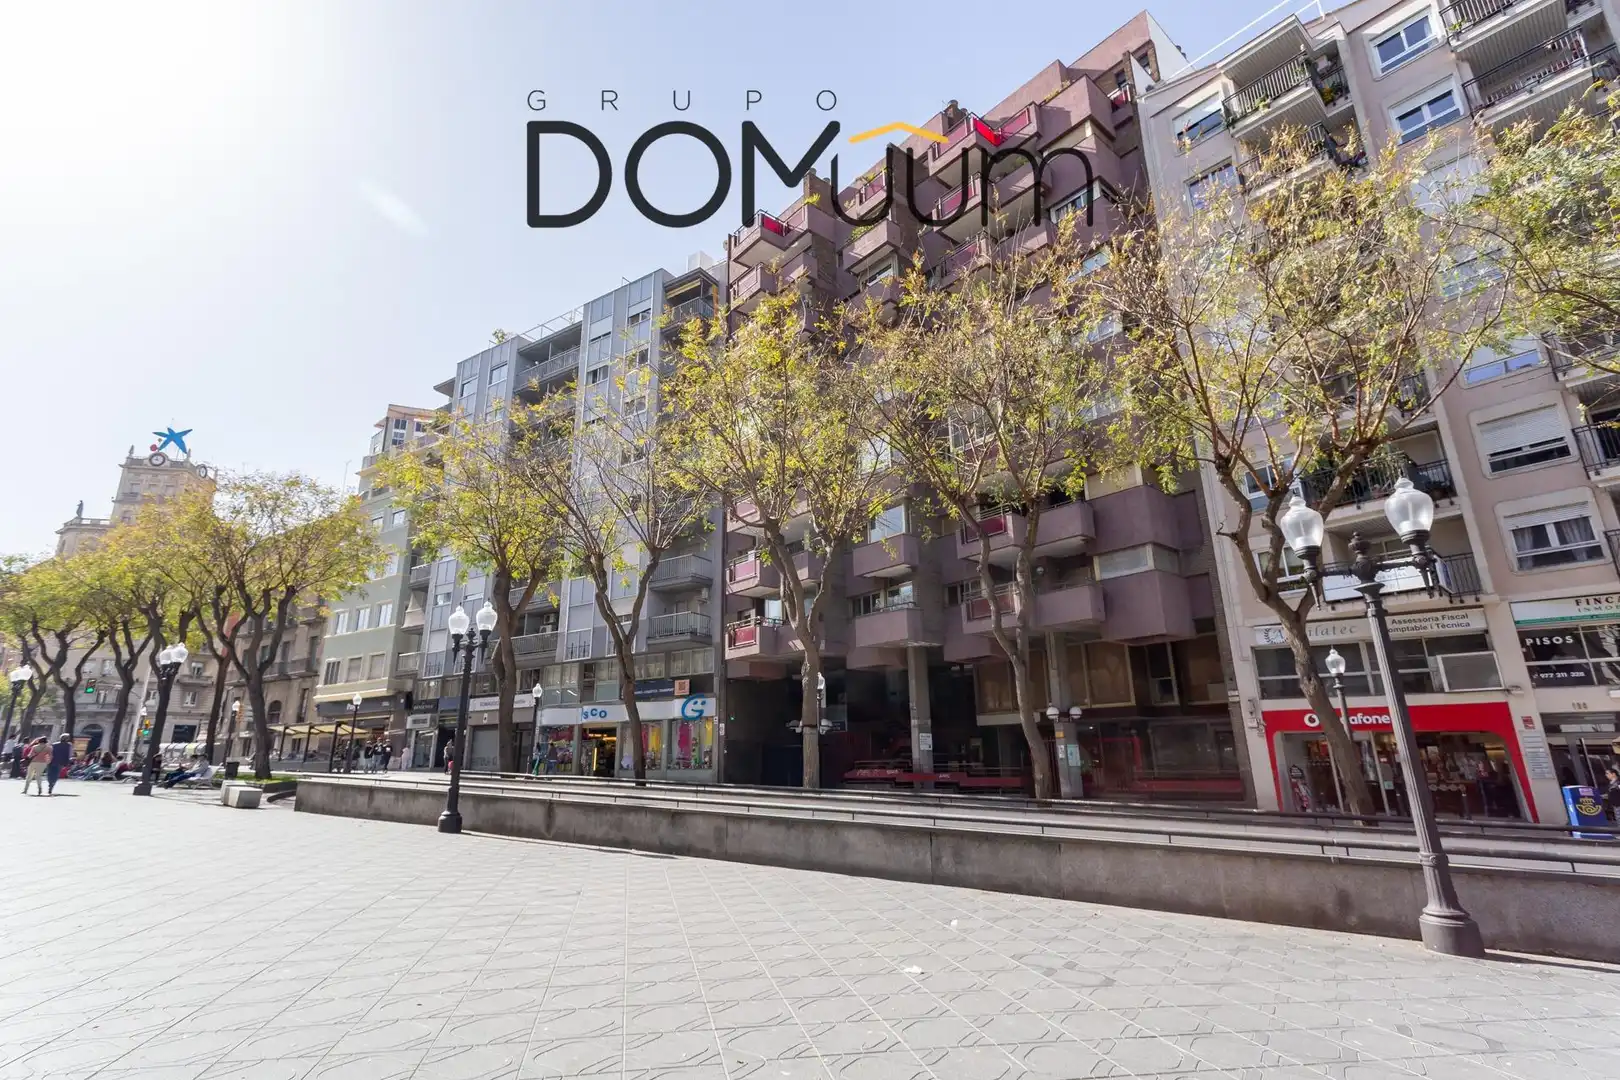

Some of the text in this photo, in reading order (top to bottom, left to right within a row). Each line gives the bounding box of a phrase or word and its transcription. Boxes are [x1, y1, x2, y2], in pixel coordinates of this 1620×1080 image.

[1442, 613, 1468, 621] Fiscal
[1388, 624, 1428, 634] omptable
[1525, 636, 1574, 646] PISOS
